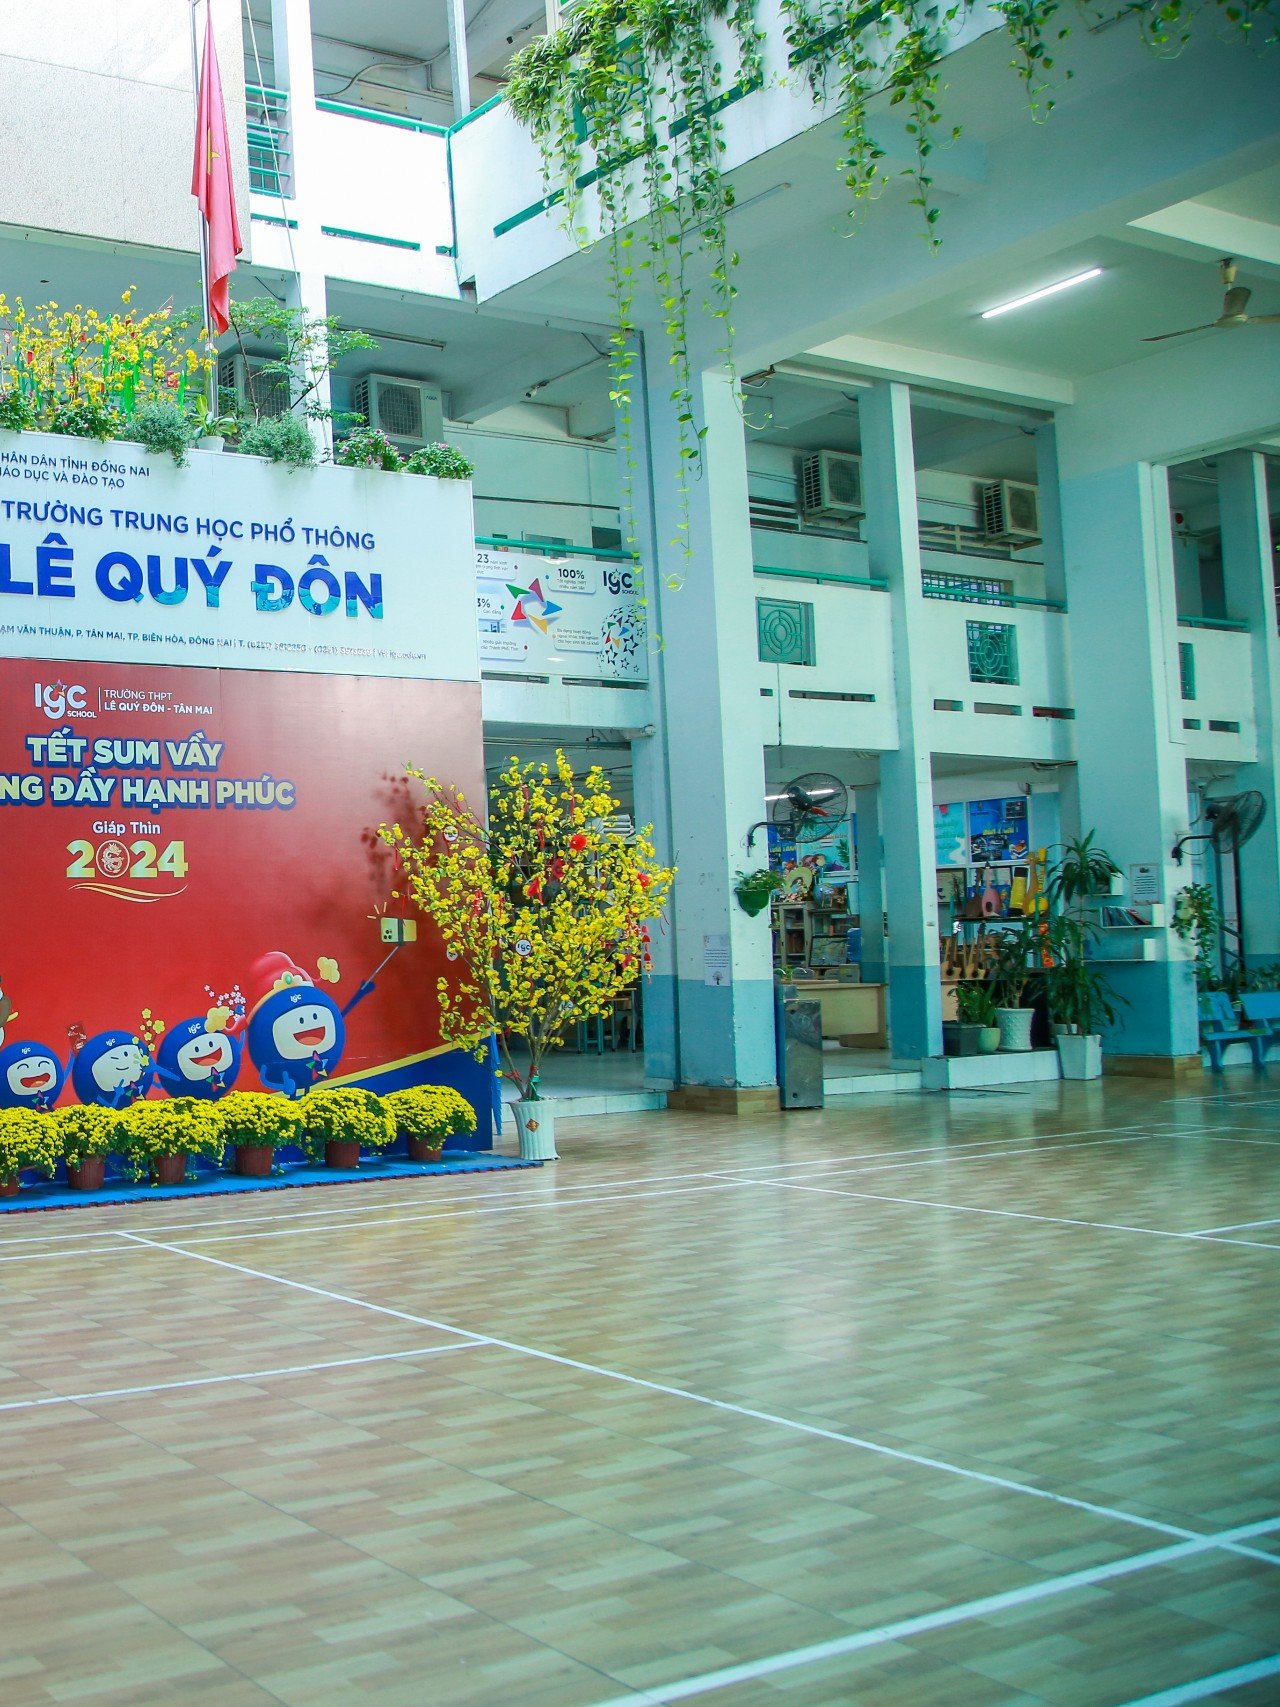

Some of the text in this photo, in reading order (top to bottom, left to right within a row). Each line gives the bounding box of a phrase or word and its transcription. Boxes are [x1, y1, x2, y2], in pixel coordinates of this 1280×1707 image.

[31, 453, 57, 467] DÂN
[60, 456, 88, 470] TỈNH
[91, 460, 126, 474] ĐỒNG
[130, 466, 150, 477] NAI
[24, 470, 50, 483] DỤC
[53, 470, 68, 483] VÀ
[72, 472, 98, 486] ĐÀO
[102, 476, 125, 490] TẠO
[1, 500, 376, 551] TRƯỜNG TRUNG HỌC PHỔ THÔNG
[477, 553, 489, 564] 23
[95, 544, 234, 608] QUÝ
[250, 553, 385, 620] ĐÔN
[558, 568, 585, 580] 100%
[17, 624, 37, 634] VĂN
[39, 626, 74, 637] THUẬN,
[86, 628, 104, 639] TÂN
[106, 630, 126, 641] MAI,
[142, 632, 163, 643] BIÊN
[104, 688, 172, 701] TRƯỜNG THPT
[67, 710, 97, 719] SCHOOL
[104, 699, 213, 715] LÊ QUÝ ĐÔN TÂN MAI
[27, 727, 223, 768] TẾT SUM VẦY
[51, 766, 115, 803] ĐẦY
[123, 778, 209, 809] HẠNH
[216, 775, 295, 806] PHÚC
[93, 820, 161, 836] Giáp Thìn
[66, 838, 189, 879] 2024
